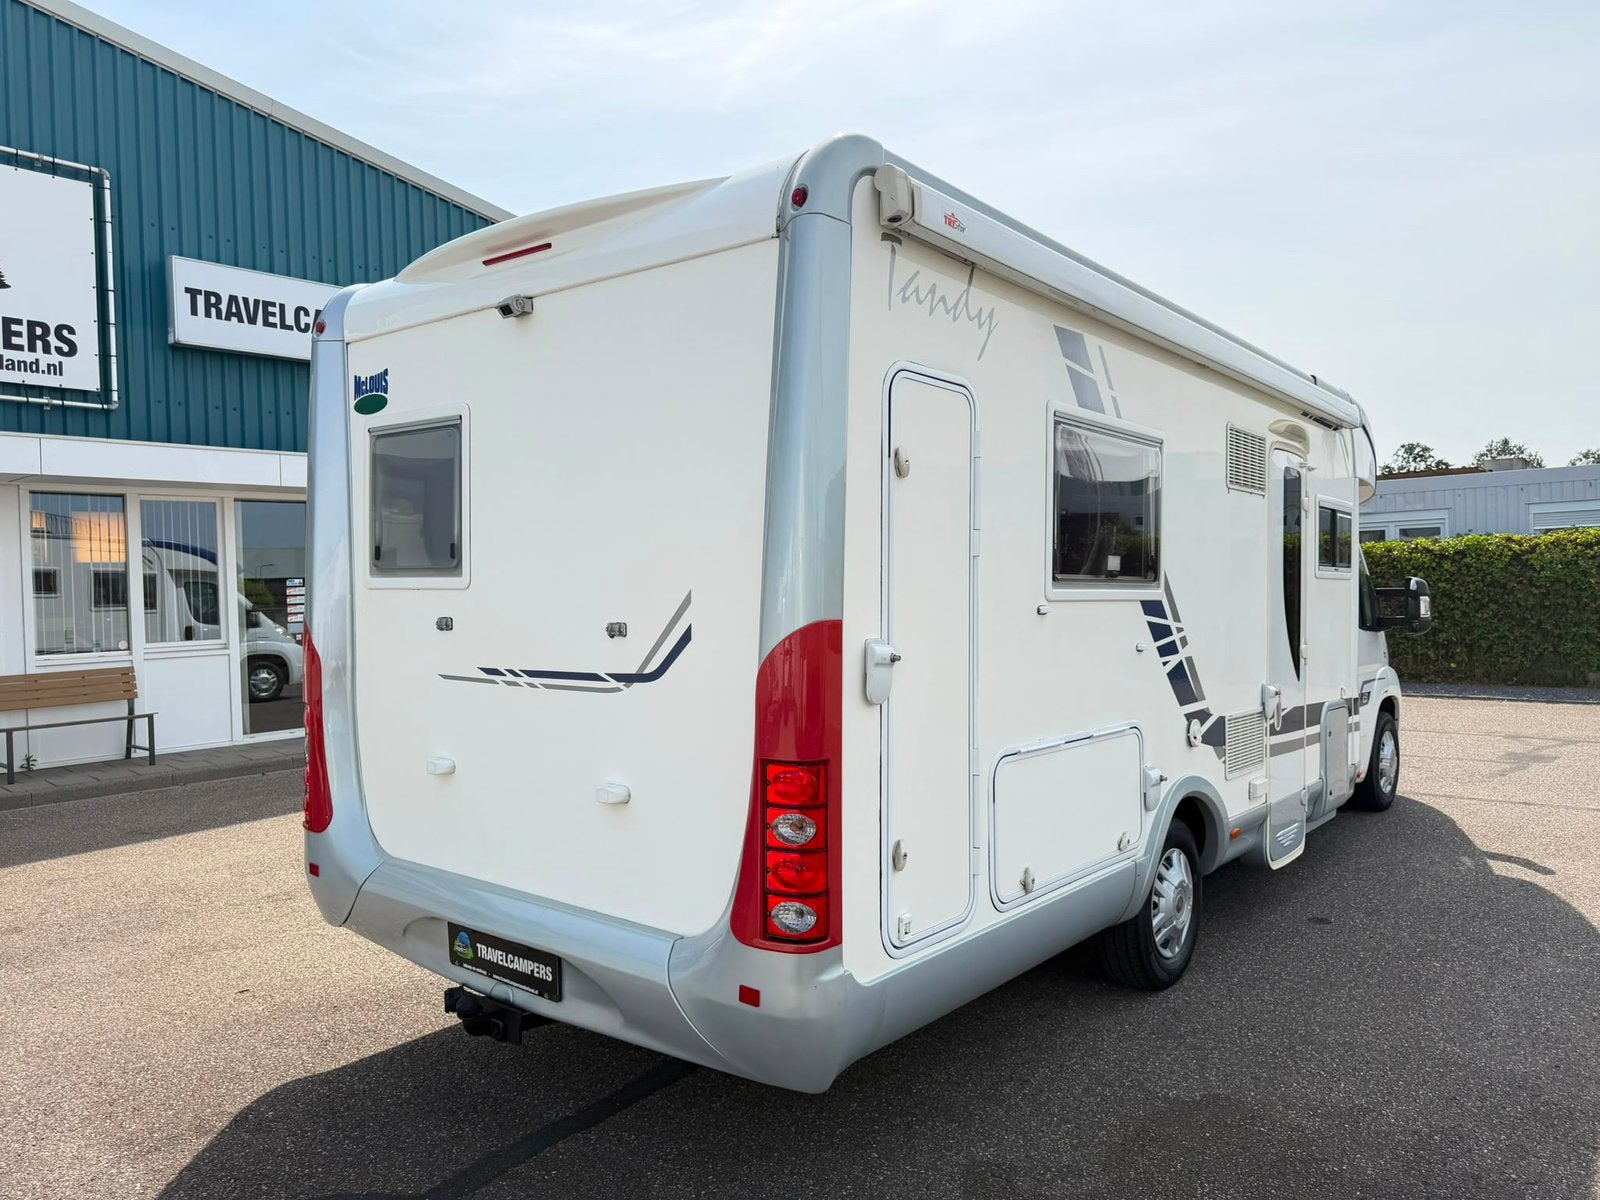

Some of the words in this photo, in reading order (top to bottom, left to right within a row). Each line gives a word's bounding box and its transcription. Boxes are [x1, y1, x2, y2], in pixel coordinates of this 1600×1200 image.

[881, 232, 999, 361] Tandy
[1, 315, 78, 358] ERS
[476, 943, 553, 982] TRAVELCAMPERS
